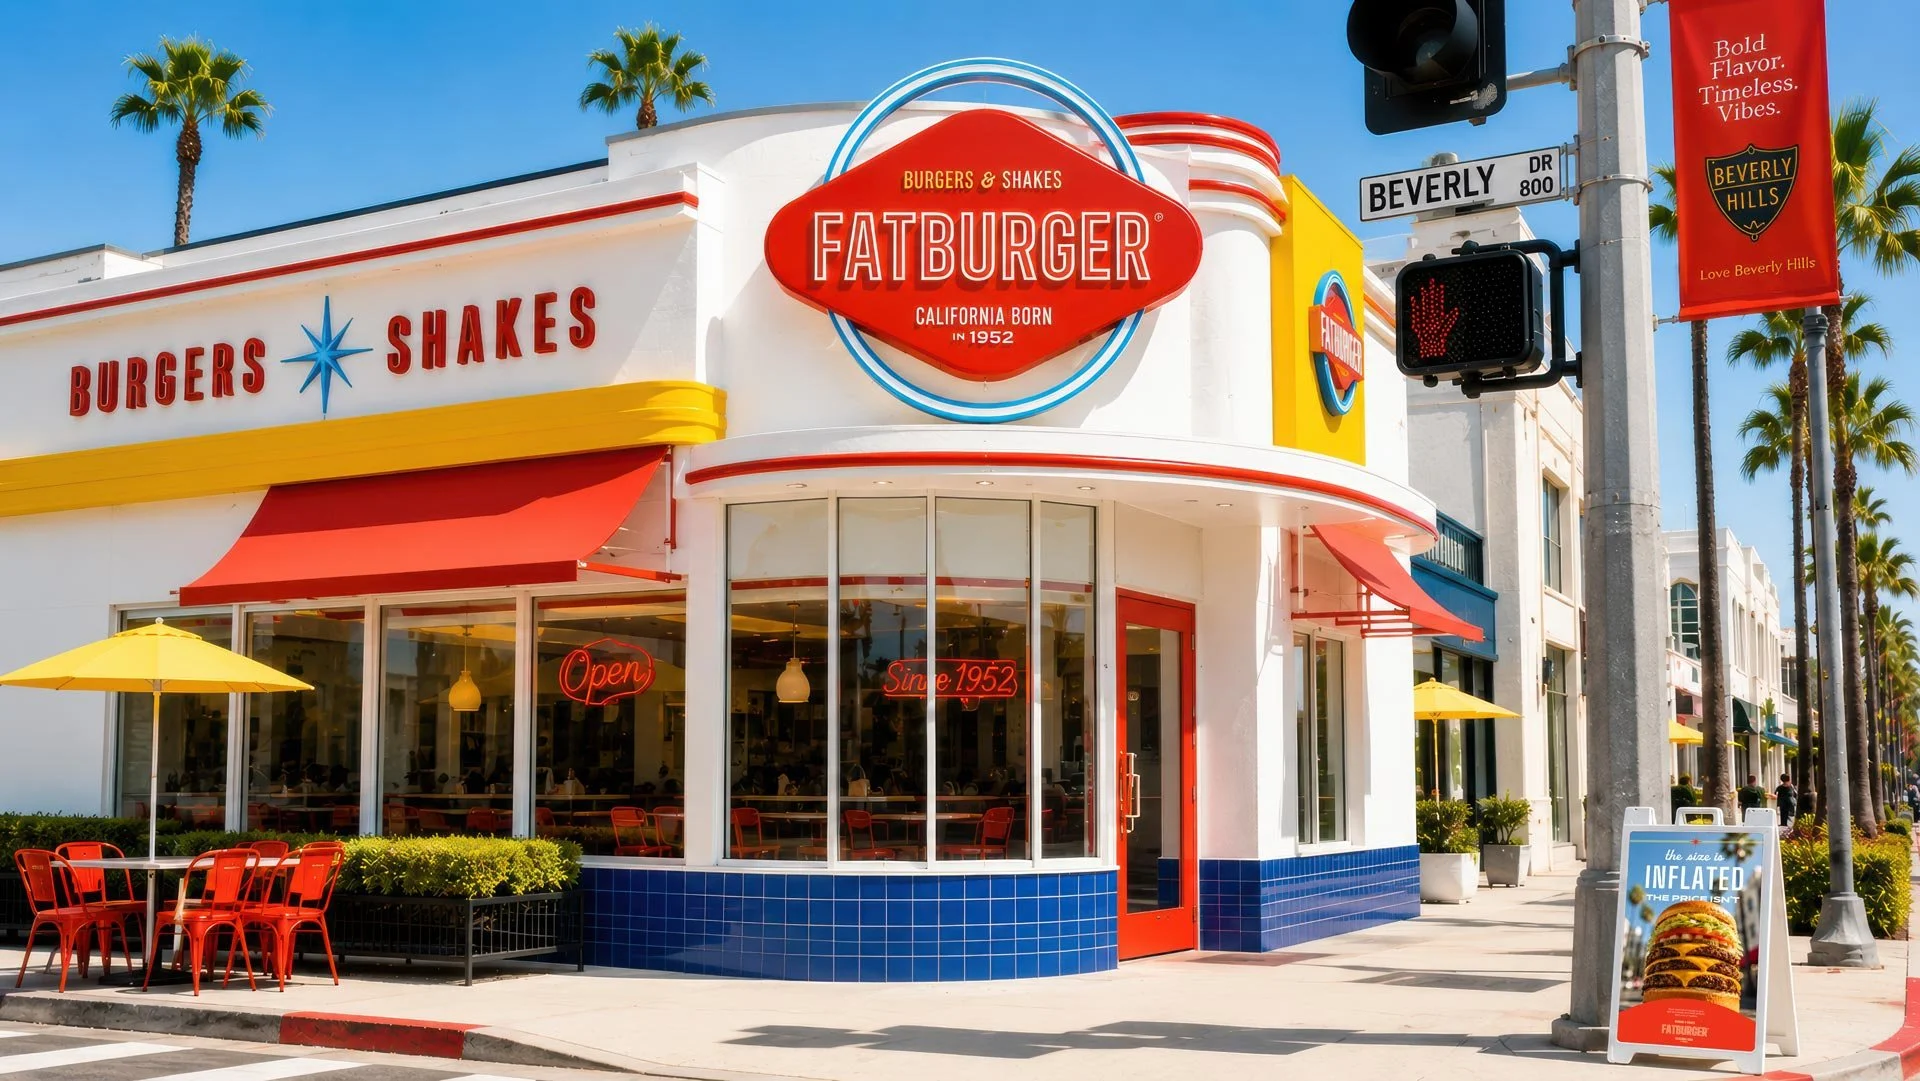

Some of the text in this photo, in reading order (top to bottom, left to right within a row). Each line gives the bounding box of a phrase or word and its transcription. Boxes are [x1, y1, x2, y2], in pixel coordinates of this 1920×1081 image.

[1714, 34, 1767, 60] Bold
[1710, 55, 1785, 80] Flavor.
[1699, 78, 1799, 105] Timeless.
[1718, 101, 1781, 122] Vibes.
[903, 170, 1063, 189] BURGERS & SHAKES
[1369, 154, 1553, 213] BEVERLY DR
[1714, 157, 1793, 186] BEVERLY
[1519, 176, 1553, 197] 800
[1727, 187, 1780, 212] HILLS
[814, 211, 1151, 281] FATBURGER
[1700, 256, 1816, 281] Love Beverly Hills
[915, 306, 1053, 326] CALIFORNIA BORN
[952, 330, 1014, 344] IN 1952
[69, 286, 597, 417] BURGERS SHAKES
[564, 649, 649, 706] Open
[882, 662, 1015, 693] Sine 1952
[1664, 848, 1726, 861] the size is
[1645, 864, 1744, 891] INFLATED
[1646, 894, 1670, 902] THE
